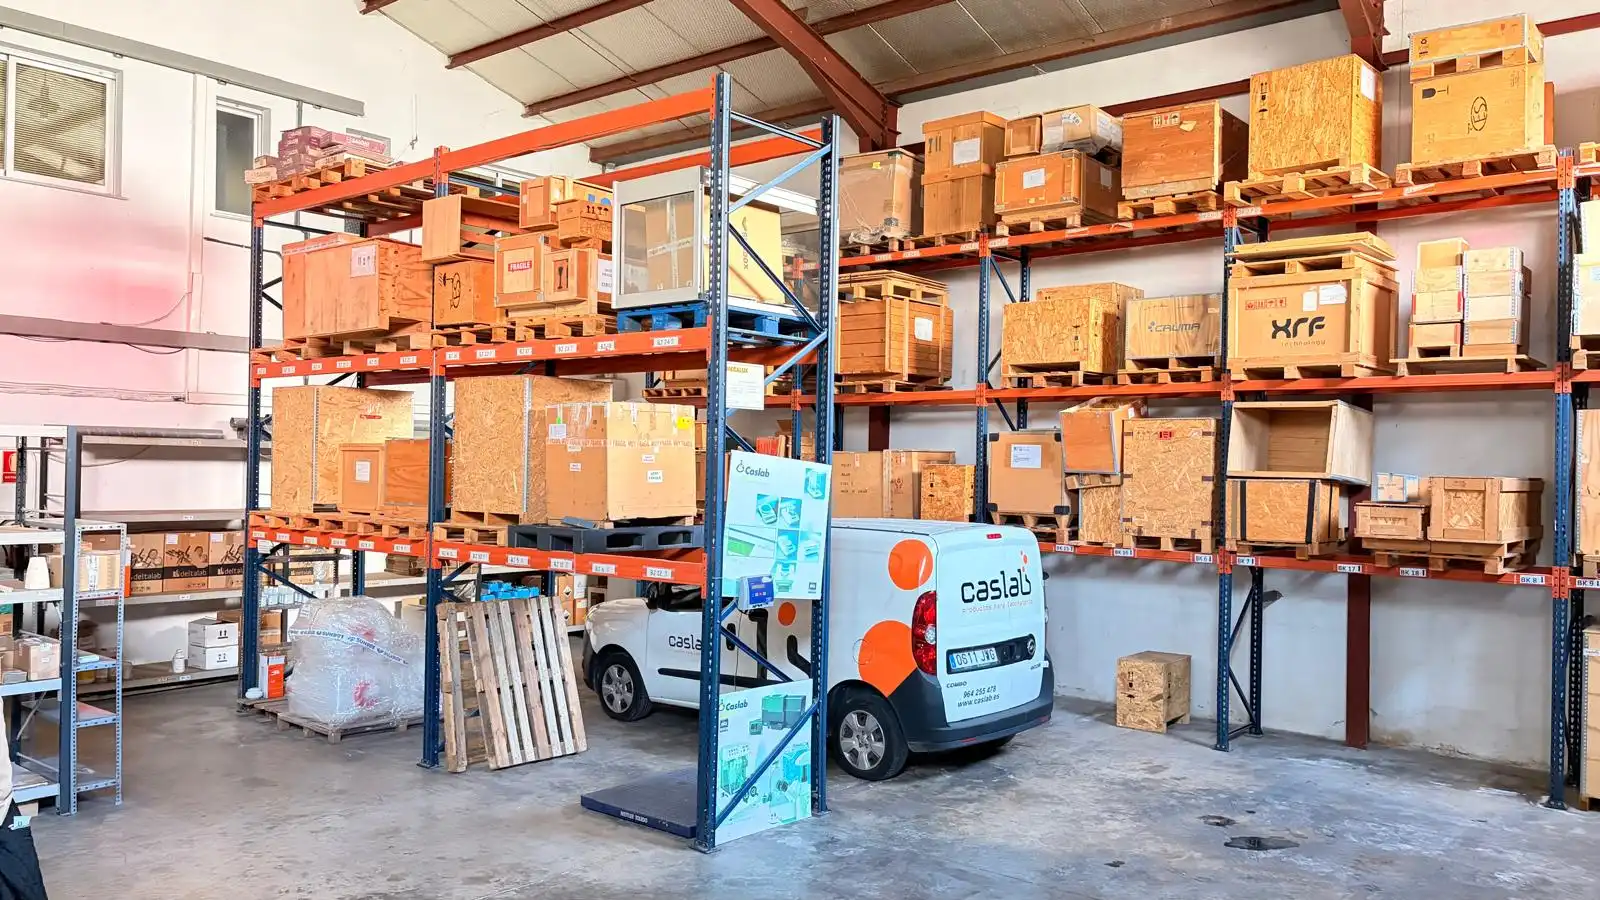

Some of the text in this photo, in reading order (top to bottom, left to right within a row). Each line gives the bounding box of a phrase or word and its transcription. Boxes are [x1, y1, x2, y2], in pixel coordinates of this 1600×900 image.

[509, 261, 531, 271] FRAGILE
[745, 466, 770, 478] Caslab
[181, 569, 207, 577] deltalab
[224, 567, 244, 575] deltal
[961, 568, 1031, 603] caslab
[668, 634, 702, 650] casla
[963, 690, 974, 698] 964
[975, 687, 986, 696] 255
[726, 698, 749, 711] Caslab
[957, 694, 1000, 707] www.caslab.es
